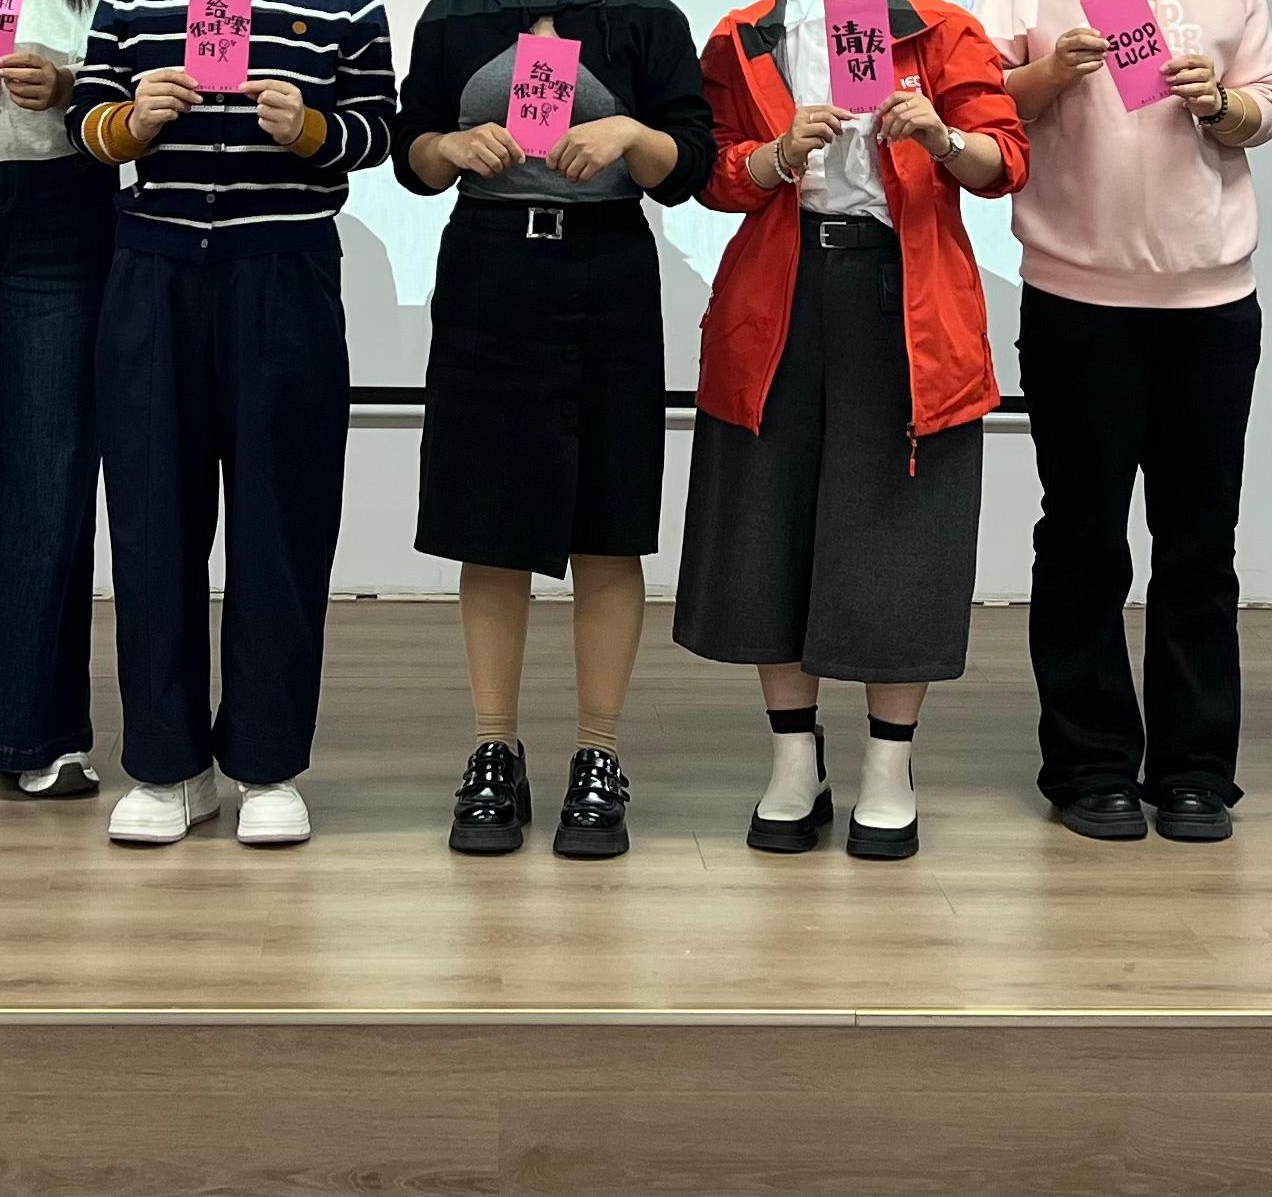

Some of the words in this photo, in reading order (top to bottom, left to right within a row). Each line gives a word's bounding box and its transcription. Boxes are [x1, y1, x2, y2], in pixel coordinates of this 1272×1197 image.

[198, 41, 216, 57] 的
[831, 20, 886, 56] 请发
[1106, 22, 1156, 52] GOOD
[847, 54, 877, 82] 财
[1115, 39, 1161, 69] LUCK
[530, 60, 553, 82] 给
[520, 103, 538, 120] 的
